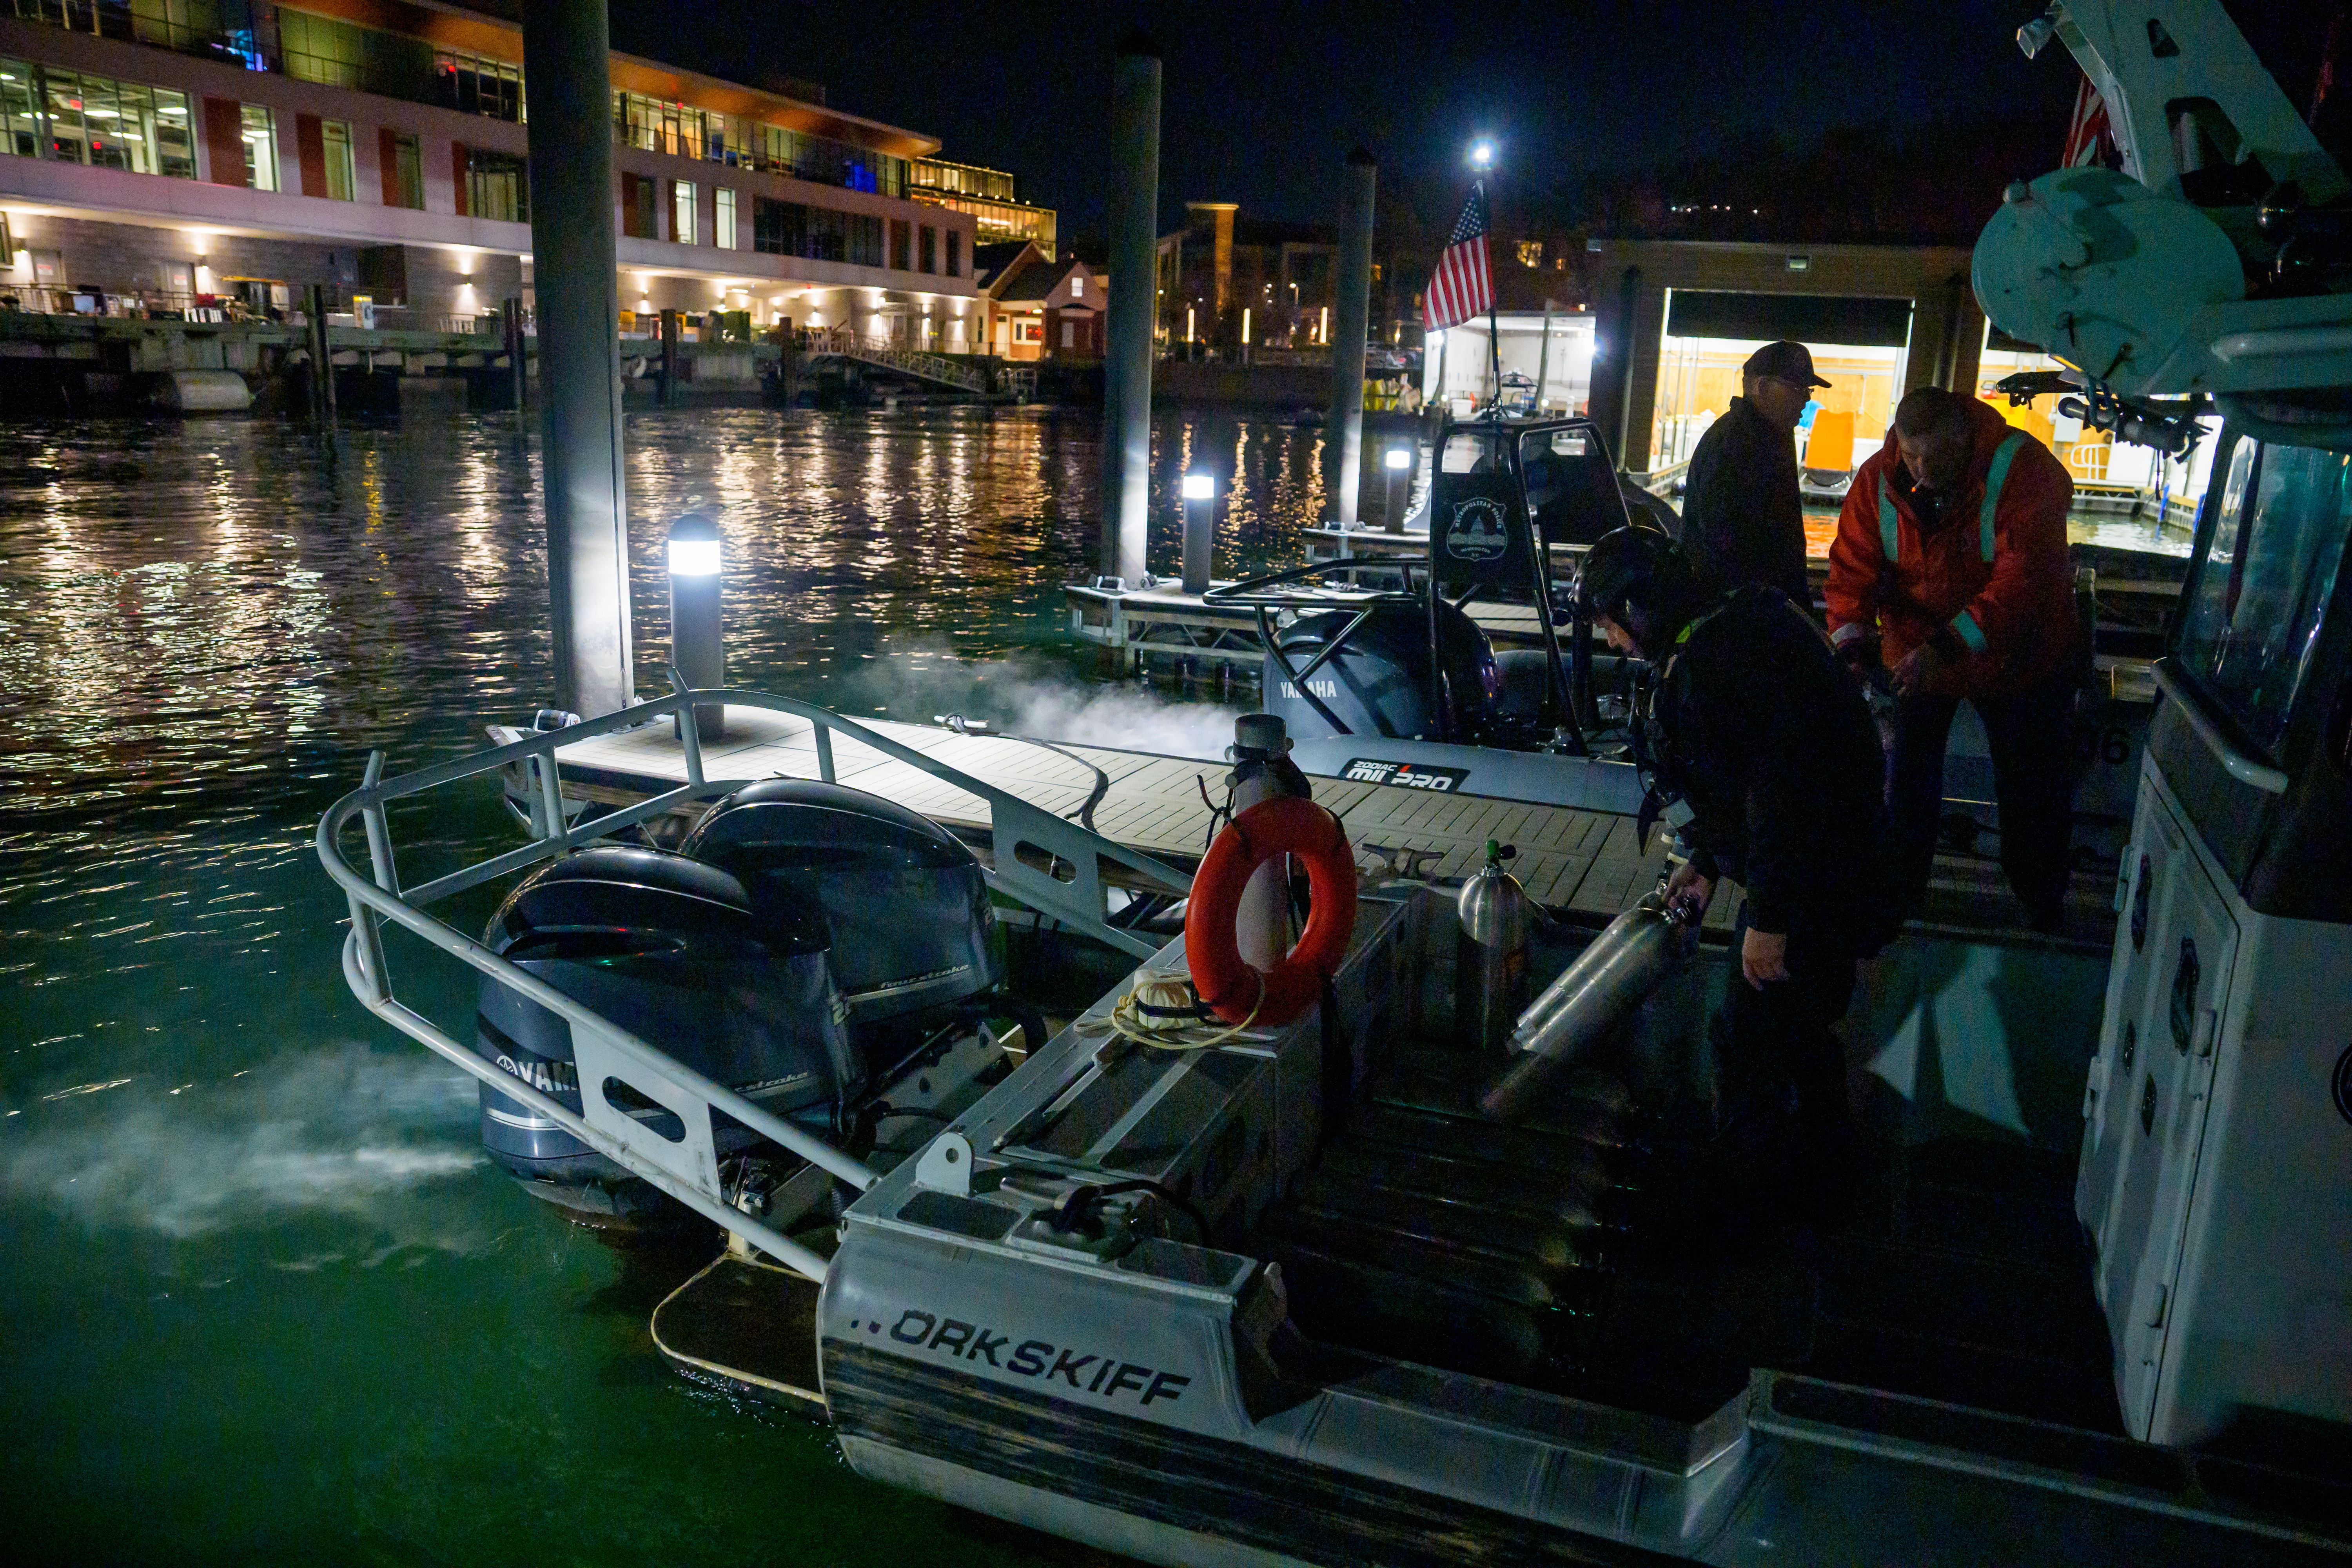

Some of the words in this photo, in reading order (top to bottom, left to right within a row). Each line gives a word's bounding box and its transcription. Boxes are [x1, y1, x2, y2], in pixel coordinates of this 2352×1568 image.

[1455, 500, 1492, 528] METROPOLITAN
[1491, 507, 1502, 529] POLICE
[1354, 760, 1398, 771] ZODIAC
[1391, 772, 1453, 790] PRO
[851, 1310, 1191, 1405] ORKSKIFF
